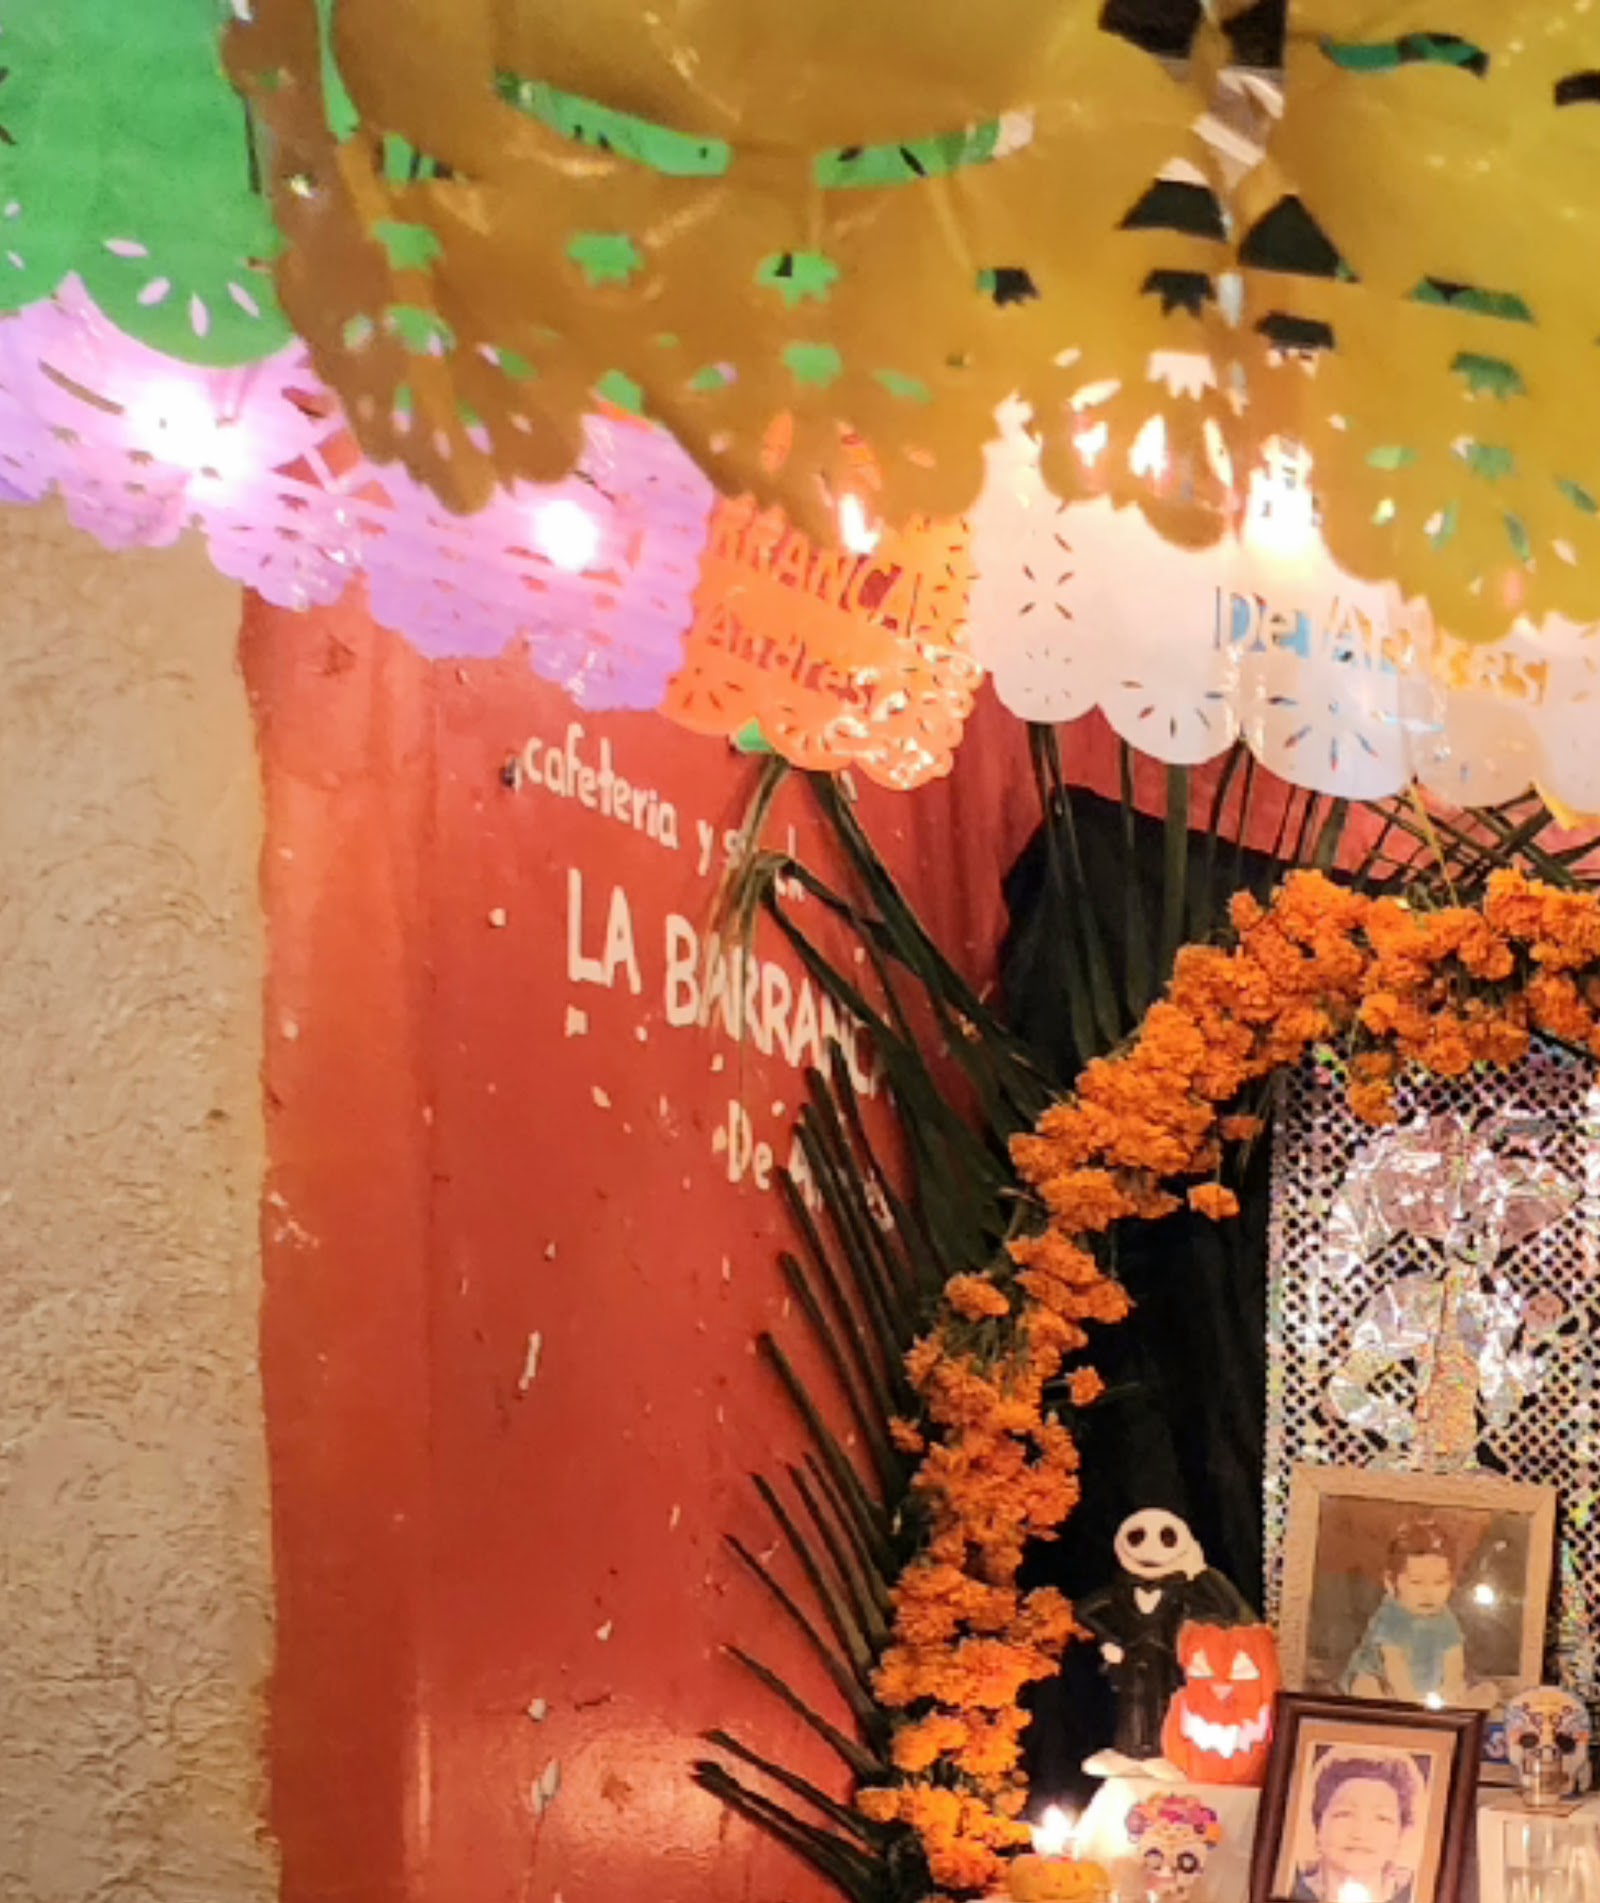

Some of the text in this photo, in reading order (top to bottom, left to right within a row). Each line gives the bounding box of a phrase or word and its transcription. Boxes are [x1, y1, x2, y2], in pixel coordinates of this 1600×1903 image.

[522, 722, 680, 851] cafeteria
[697, 817, 714, 877] y
[566, 867, 882, 1098] LA BARRANC
[727, 1099, 774, 1191] De
